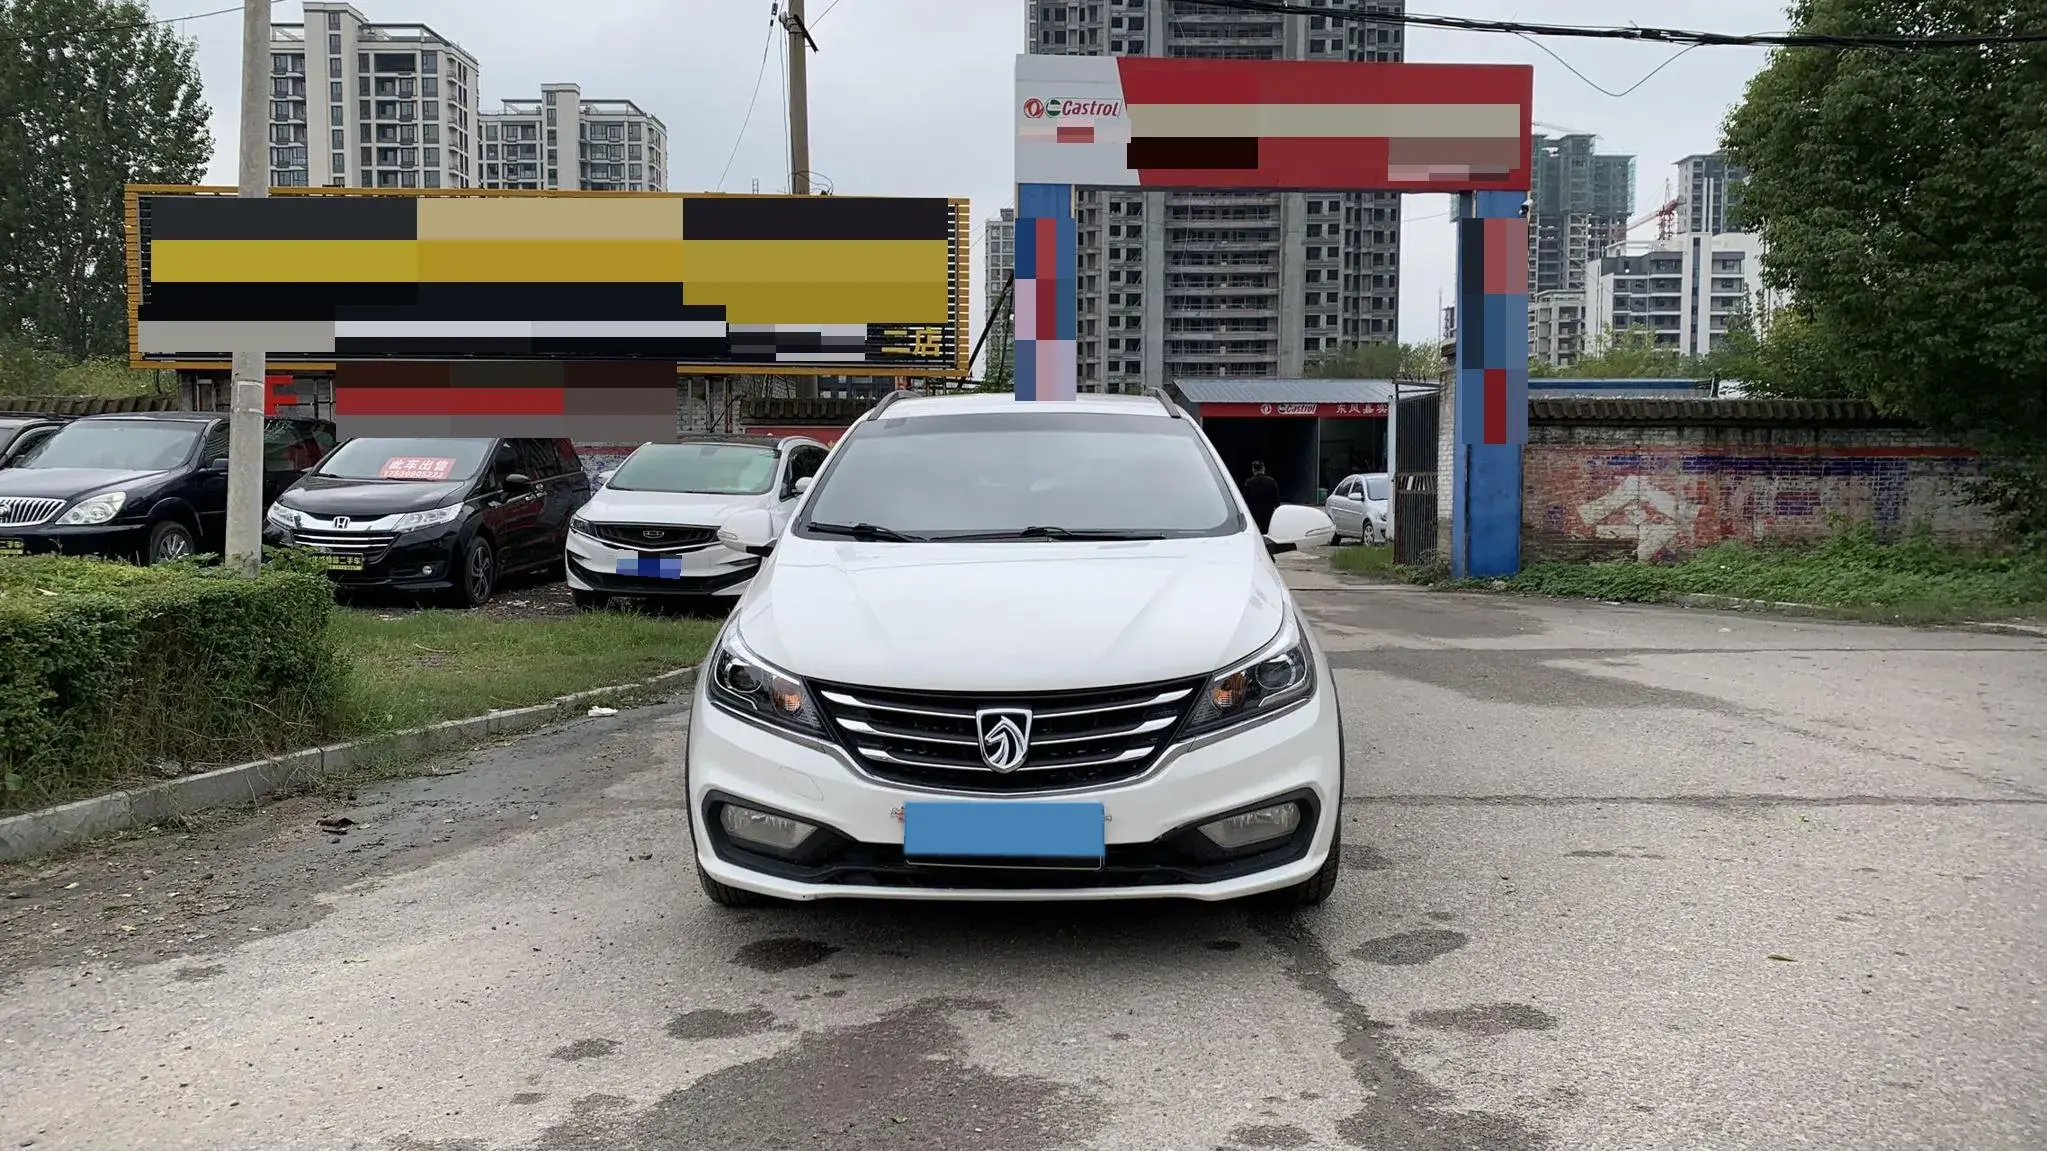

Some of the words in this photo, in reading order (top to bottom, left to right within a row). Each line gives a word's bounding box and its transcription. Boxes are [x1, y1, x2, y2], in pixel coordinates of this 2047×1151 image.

[1062, 100, 1120, 117] Castrol
[881, 327, 942, 357] 二店
[1285, 404, 1317, 414] Castrol
